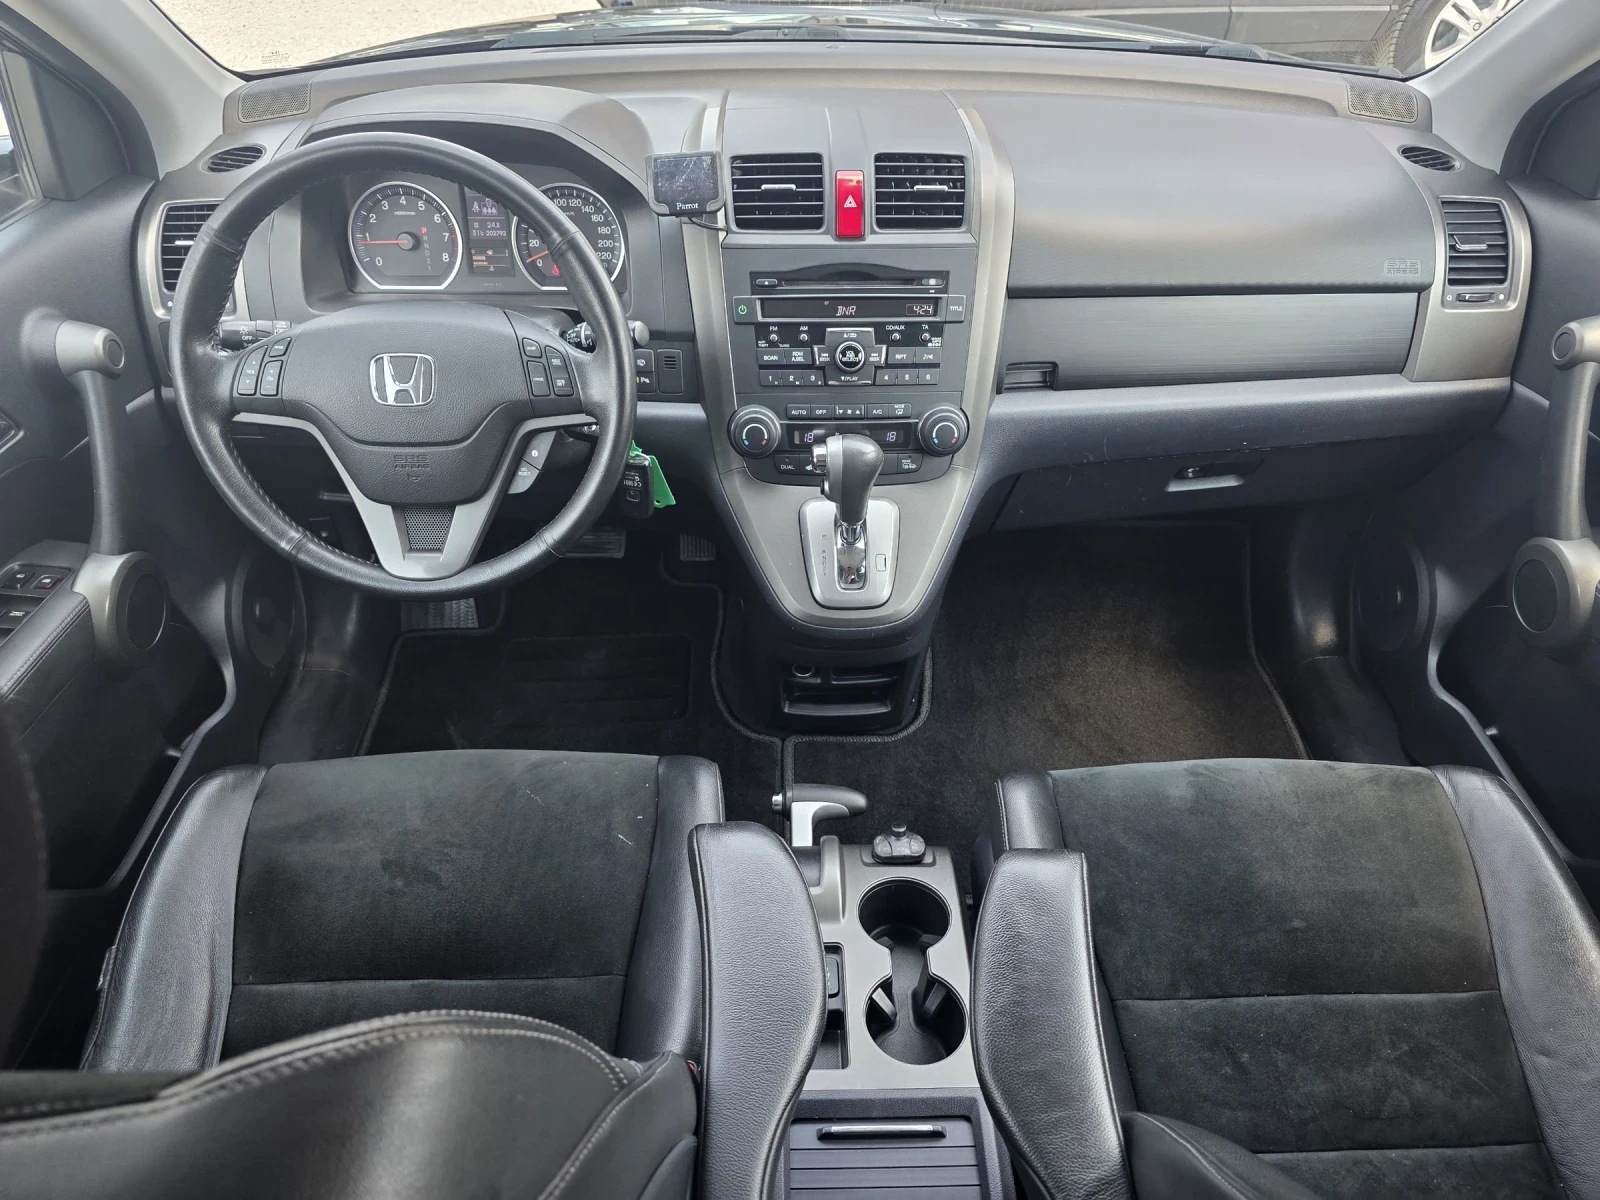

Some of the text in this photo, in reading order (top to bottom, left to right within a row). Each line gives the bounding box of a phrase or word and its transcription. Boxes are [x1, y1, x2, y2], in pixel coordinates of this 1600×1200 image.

[381, 200, 388, 210] 3
[400, 196, 406, 205] 4
[418, 201, 425, 210] 5
[370, 214, 376, 222] 2
[434, 214, 441, 223] 6
[366, 232, 370, 241] 1
[442, 233, 449, 242] 7
[376, 257, 382, 266] 0
[442, 253, 449, 262] 8
[1386, 260, 1419, 268] SRS
[914, 305, 933, 314] 4:24
[804, 432, 813, 442] 18
[886, 432, 896, 441] 18
